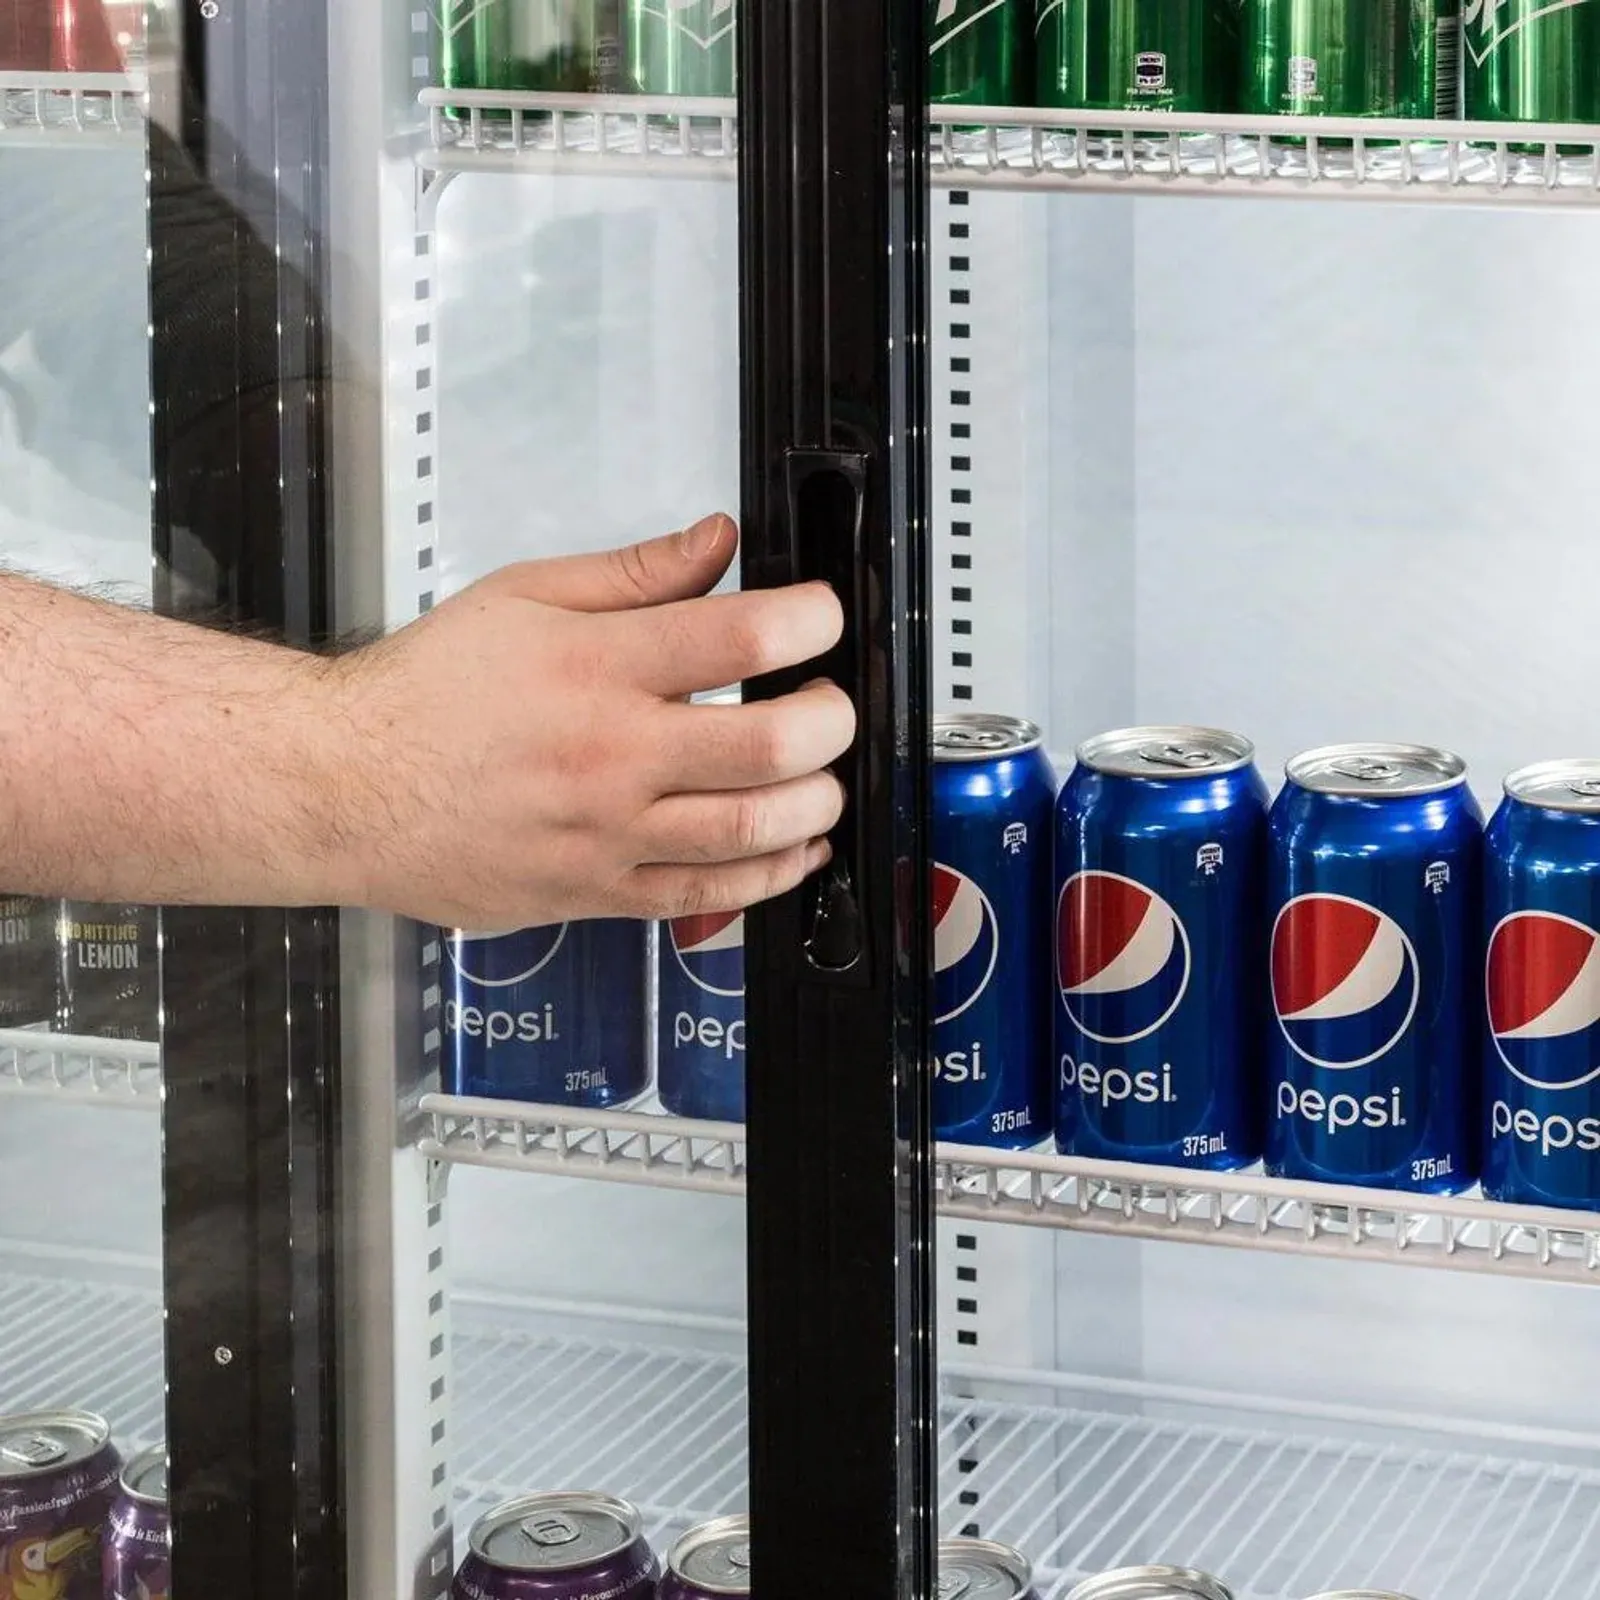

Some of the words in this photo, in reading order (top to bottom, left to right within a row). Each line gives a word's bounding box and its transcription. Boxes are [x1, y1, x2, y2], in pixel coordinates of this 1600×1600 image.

[83, 922, 139, 941] HITTING
[78, 942, 139, 969] LEMON
[445, 998, 553, 1048] pepsi
[934, 1041, 980, 1082] si
[1060, 1053, 1171, 1108] pepsi
[1277, 1081, 1401, 1134] pepsi
